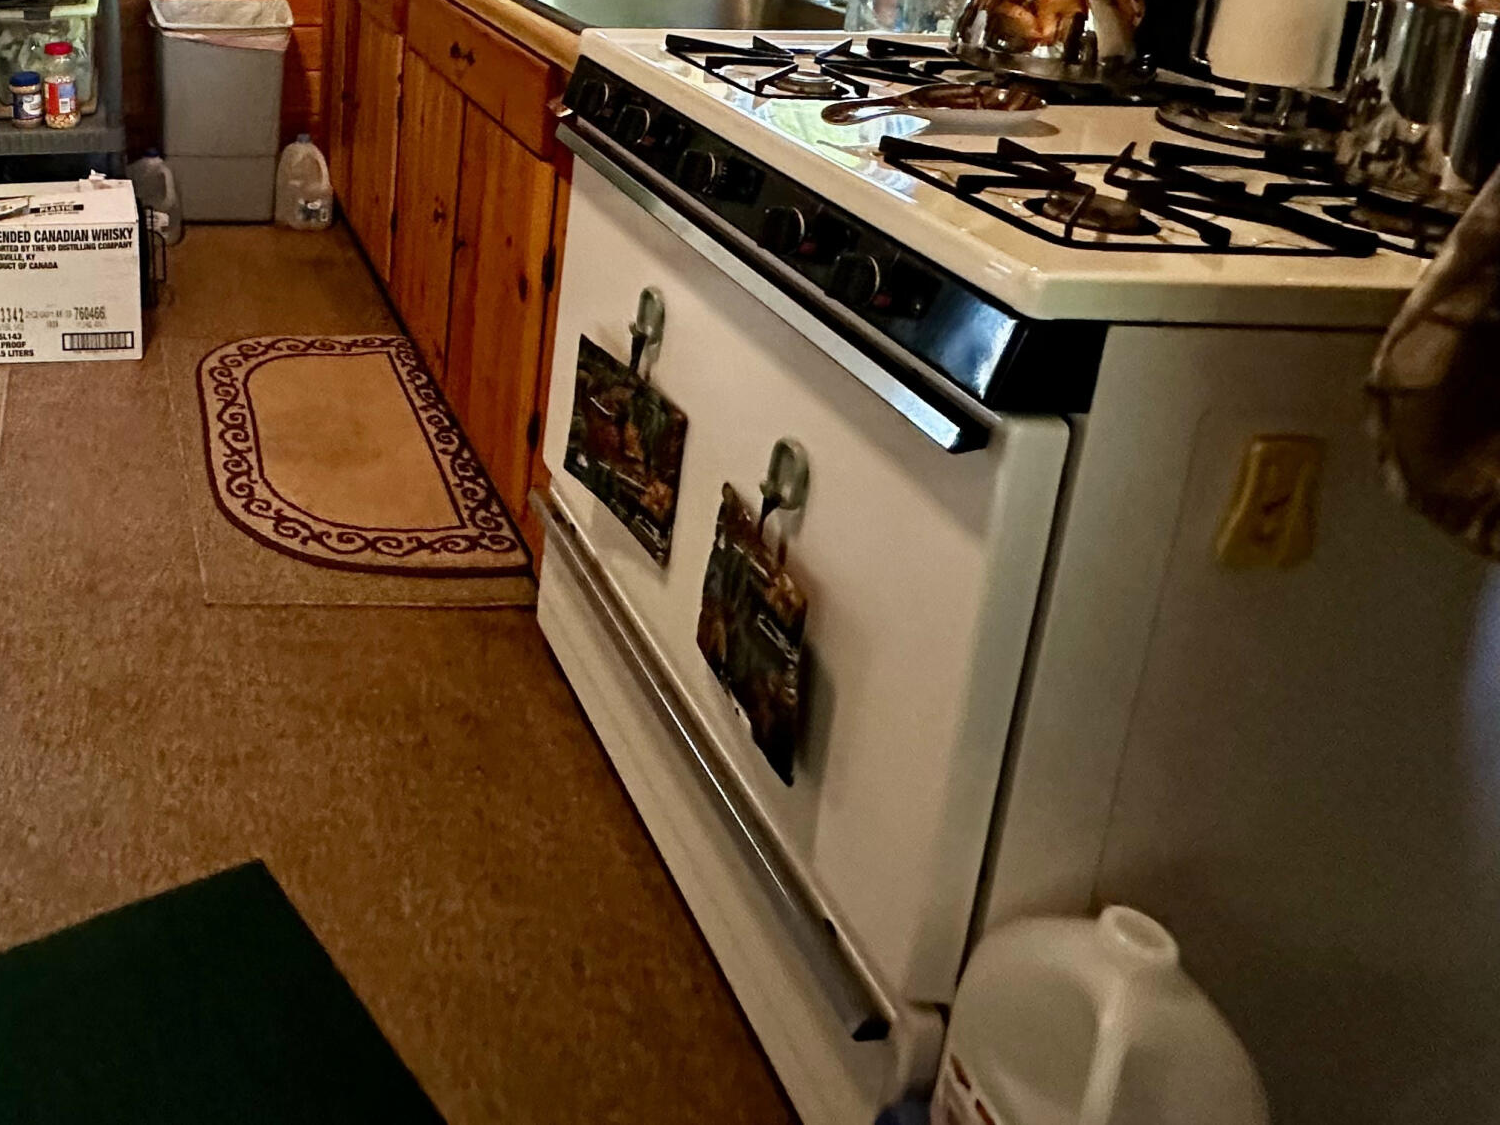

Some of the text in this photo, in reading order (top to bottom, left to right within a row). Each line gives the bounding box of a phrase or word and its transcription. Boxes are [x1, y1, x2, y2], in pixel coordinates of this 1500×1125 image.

[34, 229, 89, 243] CANADIAN
[91, 227, 134, 242] WHISKY
[20, 244, 30, 252] BY
[32, 244, 45, 252] THE
[58, 243, 96, 251] DISTILLING
[98, 241, 133, 250] COMPANY
[26, 253, 36, 261] KY
[18, 262, 28, 270] OF
[0, 341, 27, 349] PROOF
[8, 349, 35, 357] LITERS
